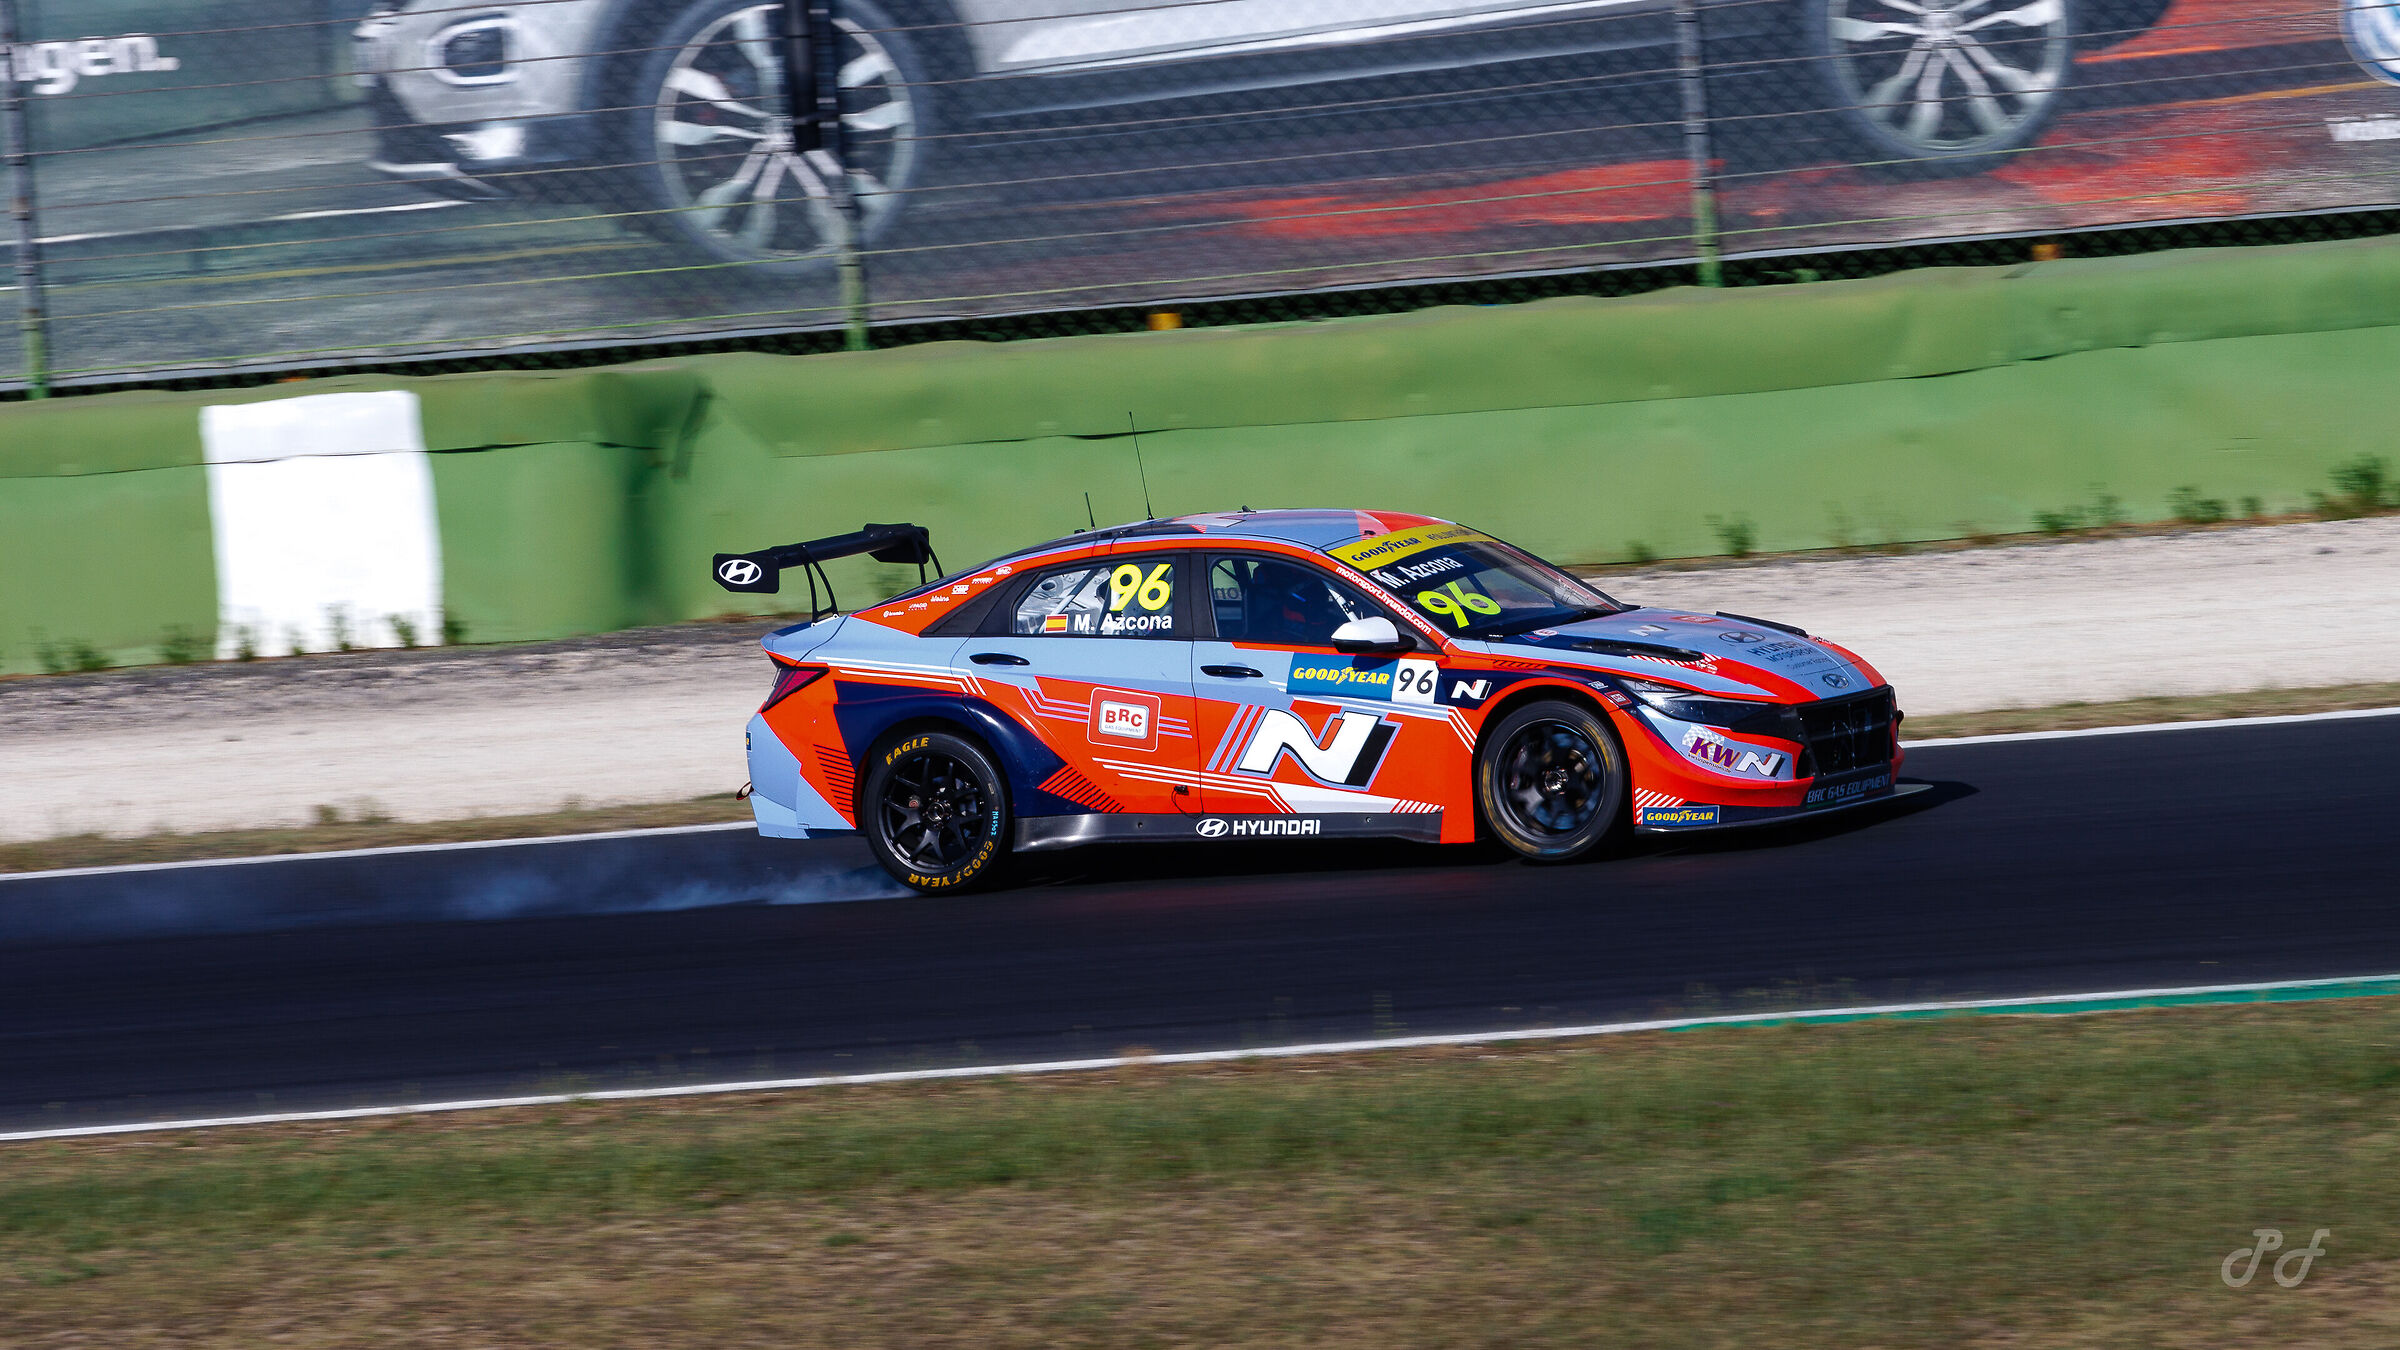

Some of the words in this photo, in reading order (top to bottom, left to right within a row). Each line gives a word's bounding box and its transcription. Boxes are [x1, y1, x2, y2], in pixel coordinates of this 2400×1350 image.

[1351, 537, 1421, 562] GOODYEAR
[1110, 563, 1171, 611] 96
[1378, 570, 1410, 590] M.
[1397, 556, 1464, 581] Azcona
[1335, 566, 1432, 635] motorsport.hyundai.com
[1417, 581, 1501, 629] 96
[1074, 613, 1096, 631] M.
[1100, 612, 1172, 631] Azcona
[1293, 666, 1390, 685] GOODYEAR
[1398, 668, 1433, 695] 96
[1105, 708, 1143, 728] BRC
[885, 736, 930, 766] EAGLE
[1689, 736, 1741, 769] KW
[1807, 787, 1827, 804] BRC
[1827, 783, 1846, 800] GAS
[1232, 819, 1321, 836] HYUNDAI
[1646, 809, 1715, 824] GOODYEAR
[908, 840, 994, 887] GOODYEAR
